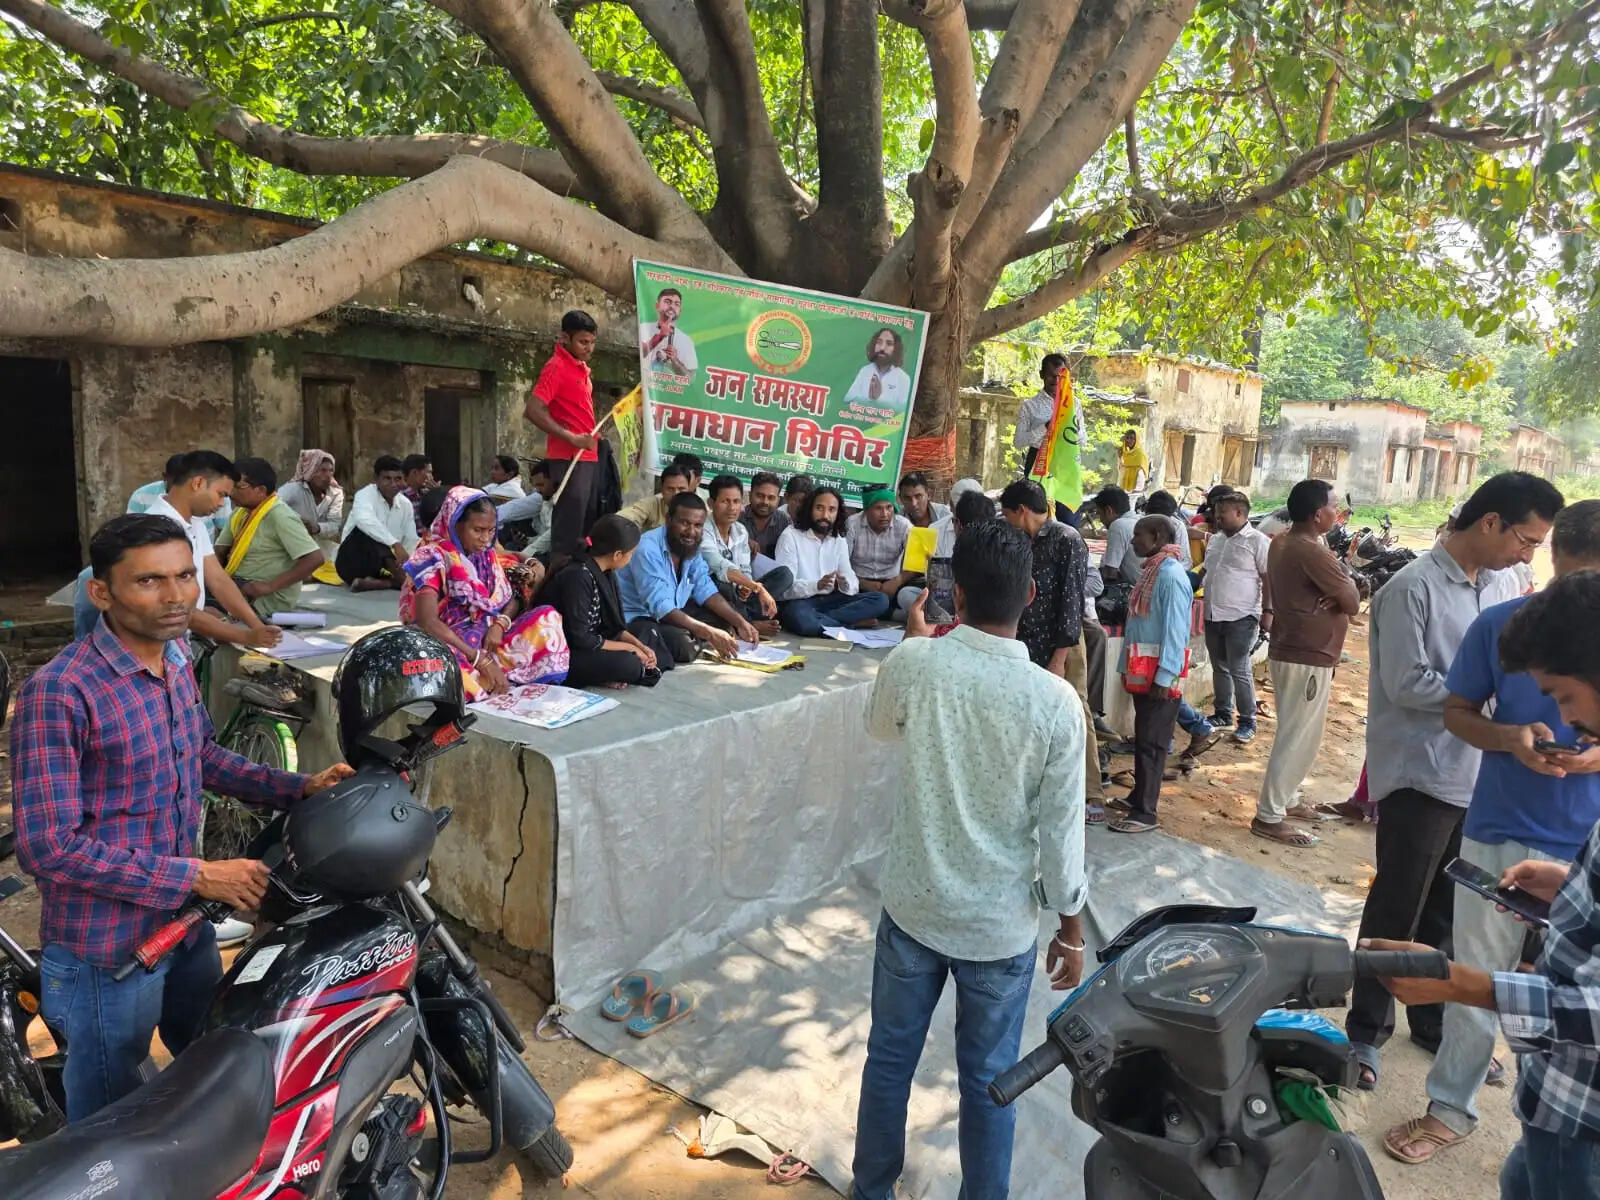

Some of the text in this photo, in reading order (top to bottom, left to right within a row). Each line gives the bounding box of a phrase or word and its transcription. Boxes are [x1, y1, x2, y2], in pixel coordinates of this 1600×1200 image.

[705, 366, 830, 416] जन समस्या
[703, 446, 731, 459] प्रखण्ड
[733, 451, 747, 461] सह
[751, 453, 775, 466] अंचल
[785, 416, 891, 469] शिविर
[297, 931, 417, 998] Passion
[376, 949, 413, 972] PRO
[292, 1157, 321, 1179] Hero
